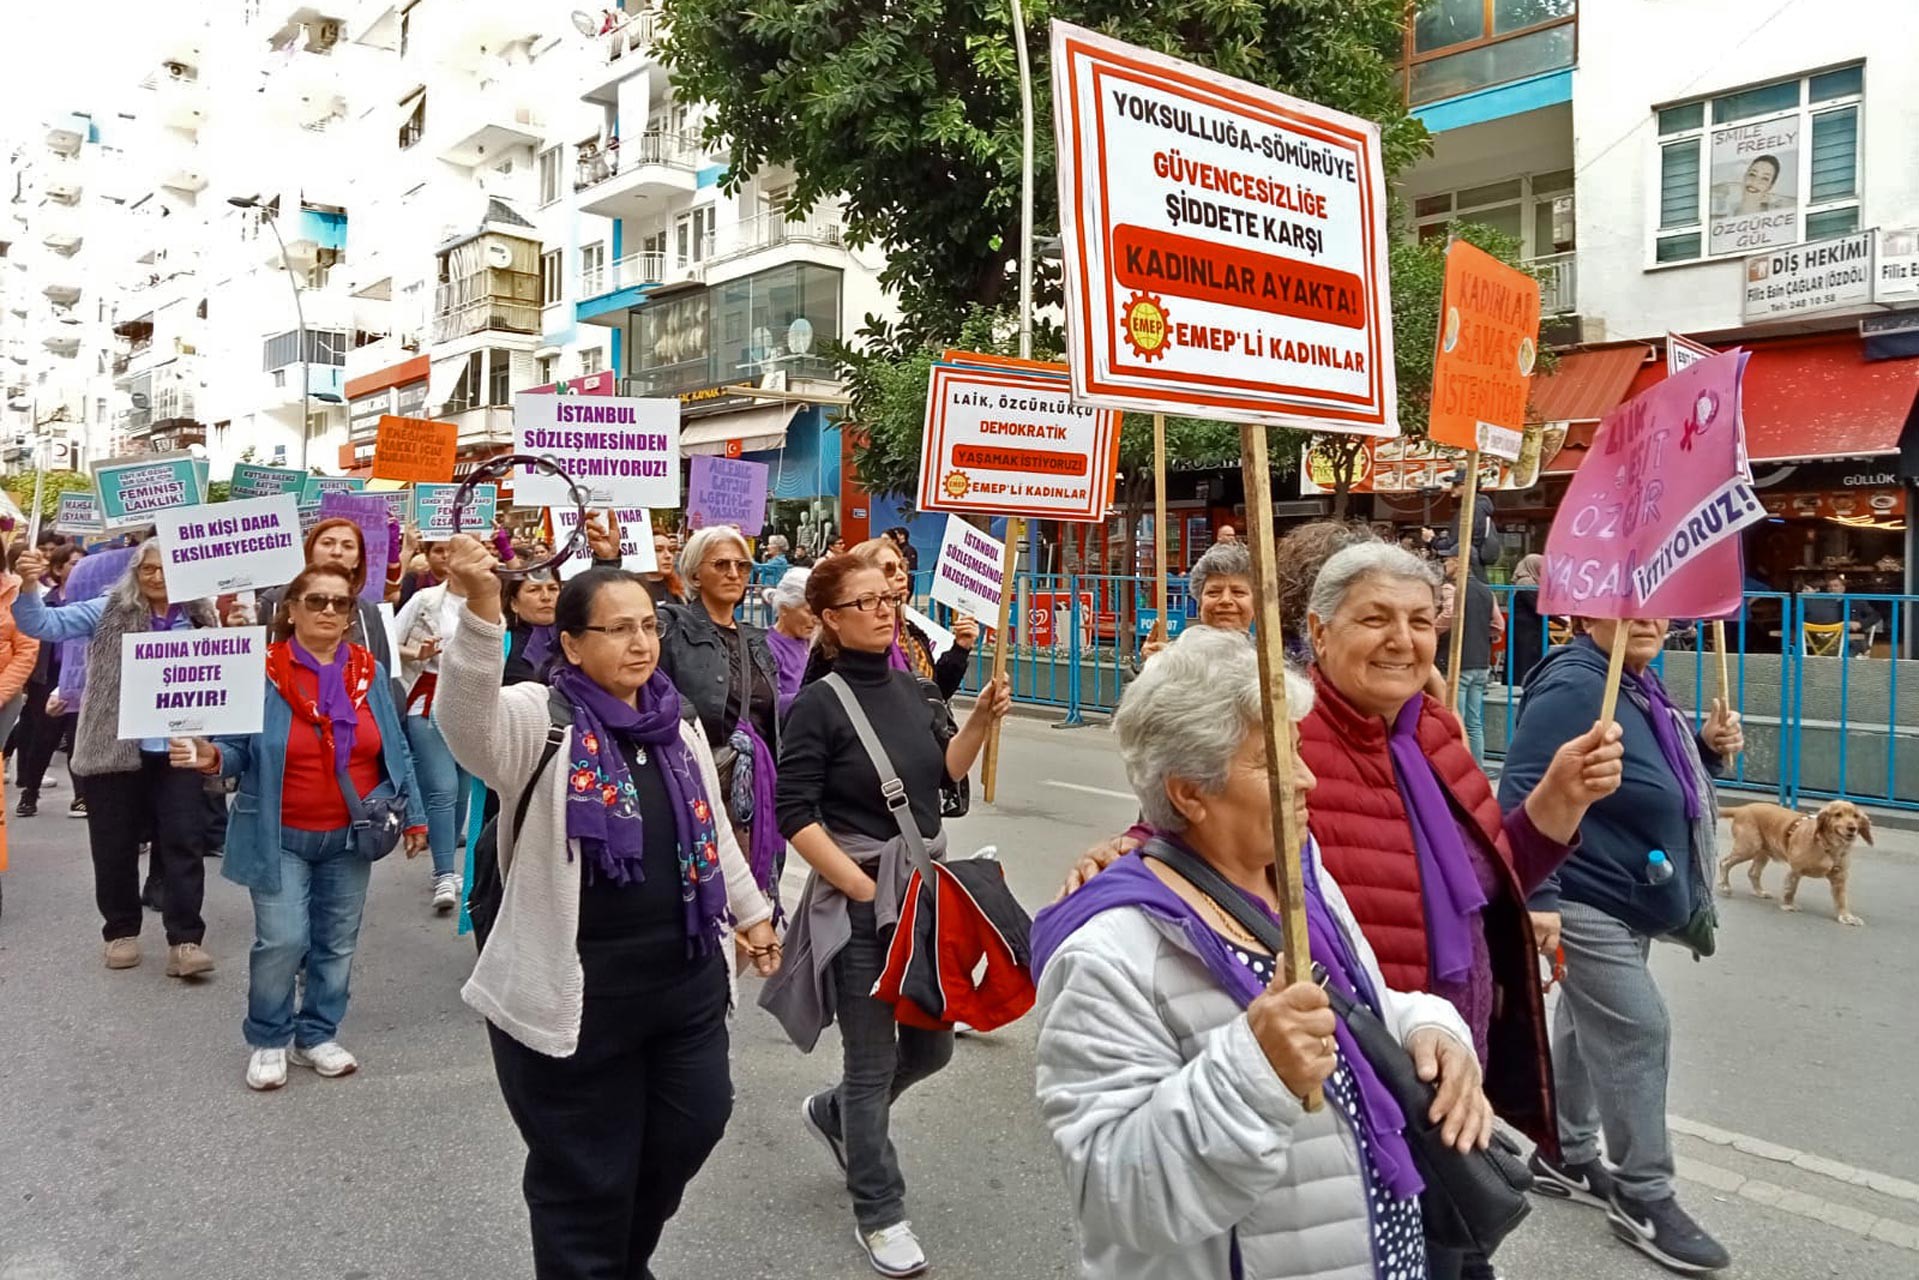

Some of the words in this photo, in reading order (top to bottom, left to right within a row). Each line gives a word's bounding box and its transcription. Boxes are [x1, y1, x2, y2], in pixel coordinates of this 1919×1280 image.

[1113, 91, 1356, 182] YOKSULLUĞA-SÖMÜRÜYE
[1715, 125, 1761, 145] SMILE
[1737, 132, 1797, 154] FREELY
[1153, 151, 1327, 219] GÜVENCESİZLİĞE
[1166, 194, 1259, 238] ŞİDDETE
[1263, 216, 1323, 257] KARŞI
[1712, 213, 1795, 236] ÖZGÜRCE
[1737, 231, 1771, 247] GÜL
[1772, 252, 1798, 276] DİŞ
[1805, 235, 1868, 269] HEKİMİ
[1126, 244, 1255, 295] KADINLAR
[1262, 271, 1358, 315] AYAKTA!
[1458, 270, 1533, 332] KADINLAR
[1132, 315, 1162, 334] EMEP
[1176, 323, 1263, 357] EMEP'Lİ
[1269, 337, 1364, 373] KADINLAR
[953, 391, 993, 408] LAİK,
[557, 402, 637, 424] İSTANBUL
[524, 428, 667, 452] SÖZLEŞMESİNDEN
[980, 420, 1067, 440] DEMOKRATİK
[525, 457, 667, 479] VGEÇMİYORUZ!
[959, 451, 1018, 466] YAŞAMAK
[1020, 455, 1082, 471] İSTİYORUZ!
[972, 482, 1022, 495] EMEP'Lİ
[1025, 486, 1087, 499] KADINLAR
[179, 523, 205, 541] BİR
[208, 516, 239, 537] KİŞİ
[241, 512, 280, 532] DAHA
[614, 509, 642, 522] YNAR
[172, 533, 292, 564] EKSİLMEYECEĞİZ!
[964, 530, 999, 561] İSTANBUL
[1638, 485, 1757, 600] İSTİYORUZ!
[945, 543, 1003, 584] SÖZLEŞMESİNDE
[942, 563, 1001, 605] VAZGEÇMİYORUZ
[135, 641, 189, 660] KADINA
[192, 636, 251, 656] YÖNELİK
[162, 664, 222, 687] ŞİDDETE
[155, 689, 227, 709] HAYIR!
